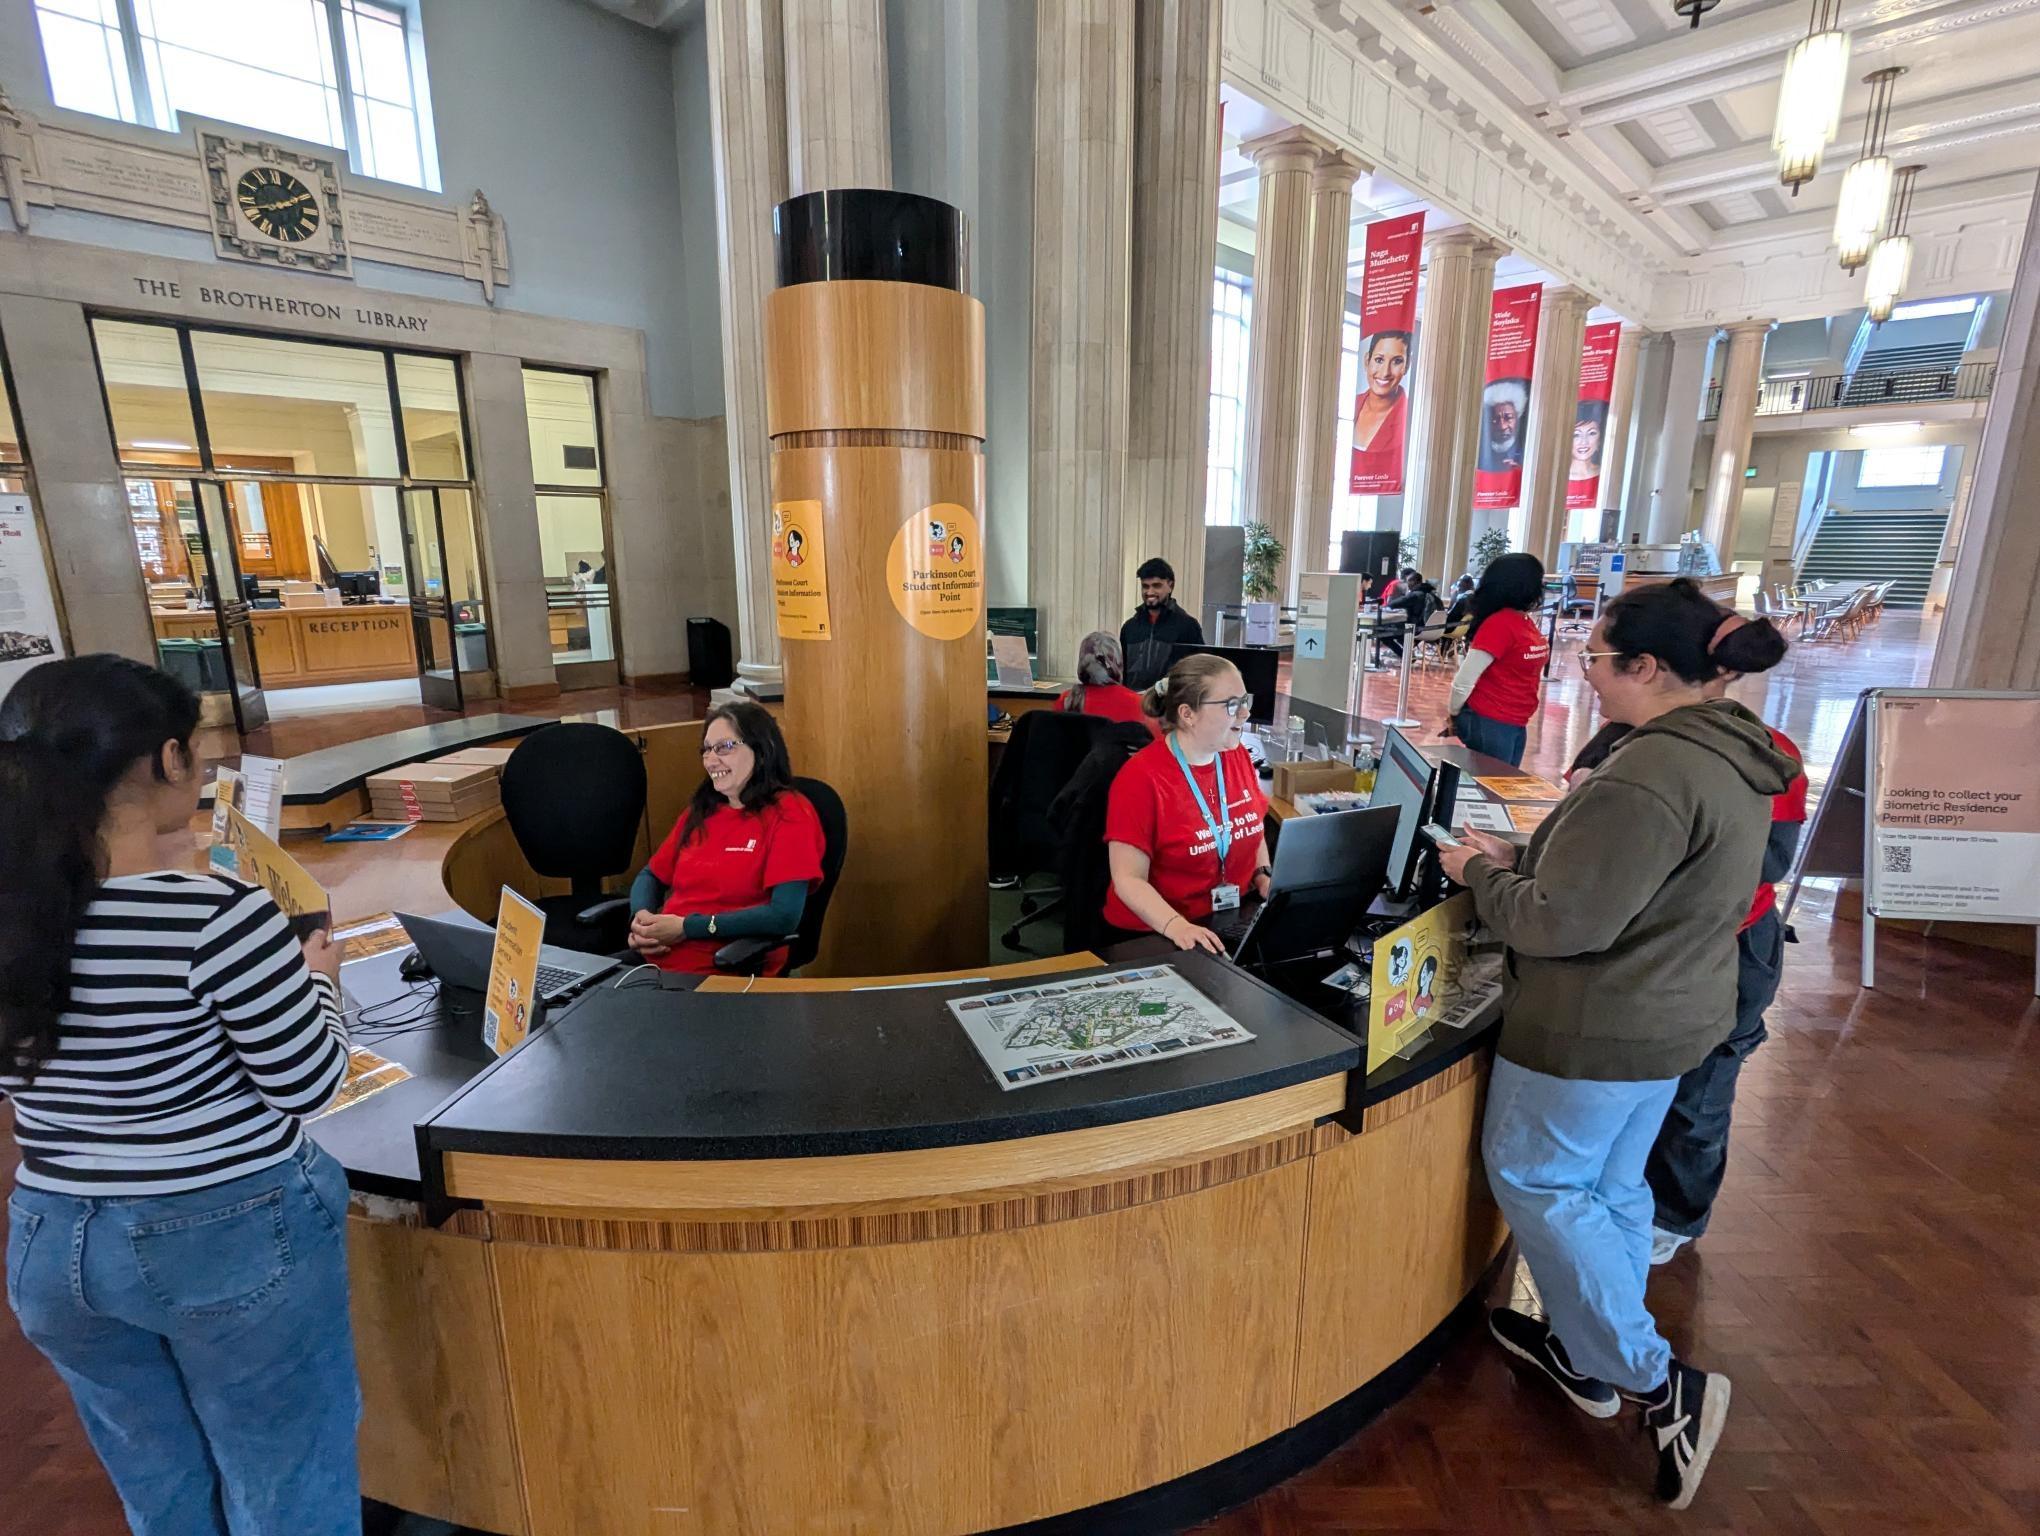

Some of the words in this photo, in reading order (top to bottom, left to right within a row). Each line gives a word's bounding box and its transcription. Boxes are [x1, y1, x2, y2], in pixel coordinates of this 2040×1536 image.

[1370, 249, 1389, 259] Naga
[1370, 254, 1410, 267] Munchetty
[133, 277, 181, 299] THE
[199, 286, 342, 320] BROTHERTON
[355, 308, 429, 333] LIBRARY
[912, 569, 958, 580] Parkinson
[958, 569, 976, 578] Court
[902, 581, 941, 592] Student
[939, 591, 961, 602] Point
[308, 618, 400, 634] RECEPTION
[1883, 787, 1930, 800] Looking
[1932, 789, 1945, 799] to
[1948, 790, 1990, 801] collect
[1994, 793, 2023, 803] your
[1883, 800, 1940, 812] Biometric
[1943, 802, 2009, 814] Residence
[1234, 817, 1245, 827] to
[1244, 811, 1258, 823] the
[1882, 813, 1921, 824] Permit
[1924, 814, 1966, 826] (BRP)?
[1234, 828, 1244, 840] of
